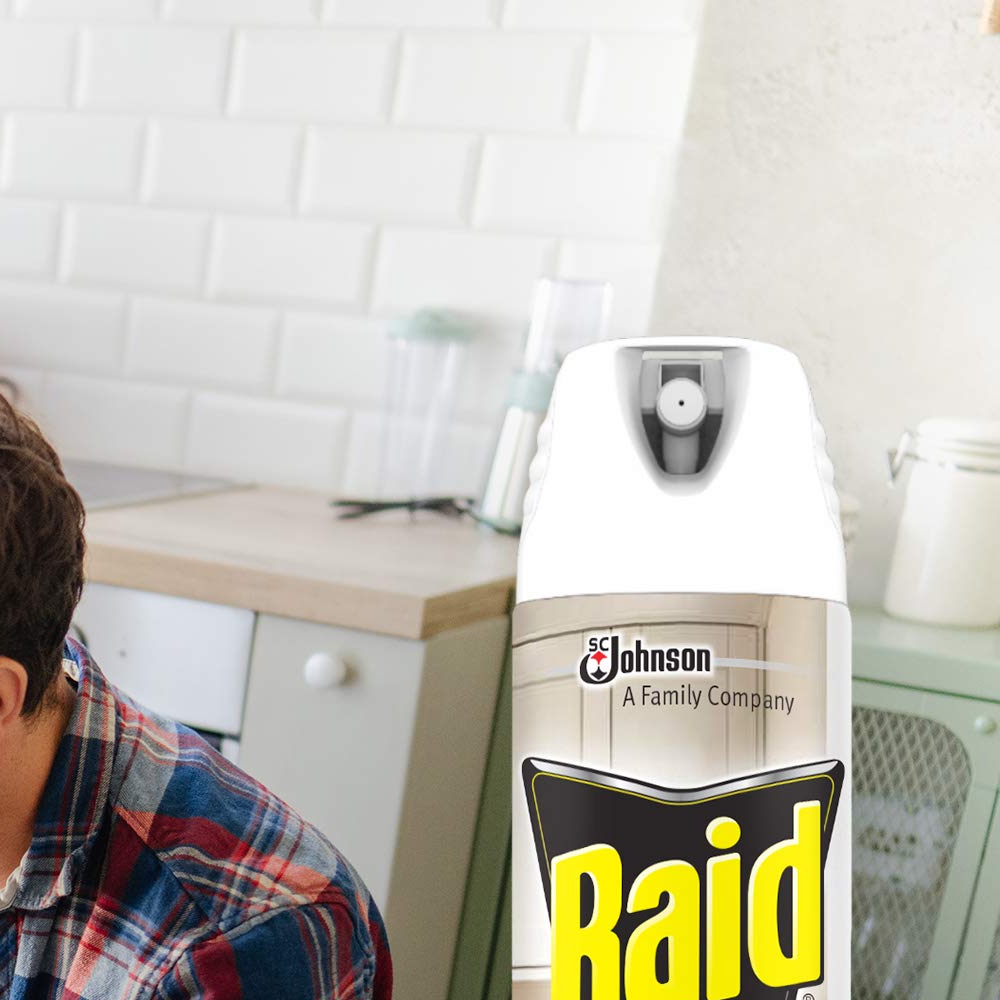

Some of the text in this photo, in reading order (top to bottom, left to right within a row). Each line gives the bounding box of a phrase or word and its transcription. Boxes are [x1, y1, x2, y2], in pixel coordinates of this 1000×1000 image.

[579, 635, 711, 684] Johnson
[588, 637, 610, 651] SC
[622, 684, 795, 715] A Family Company
